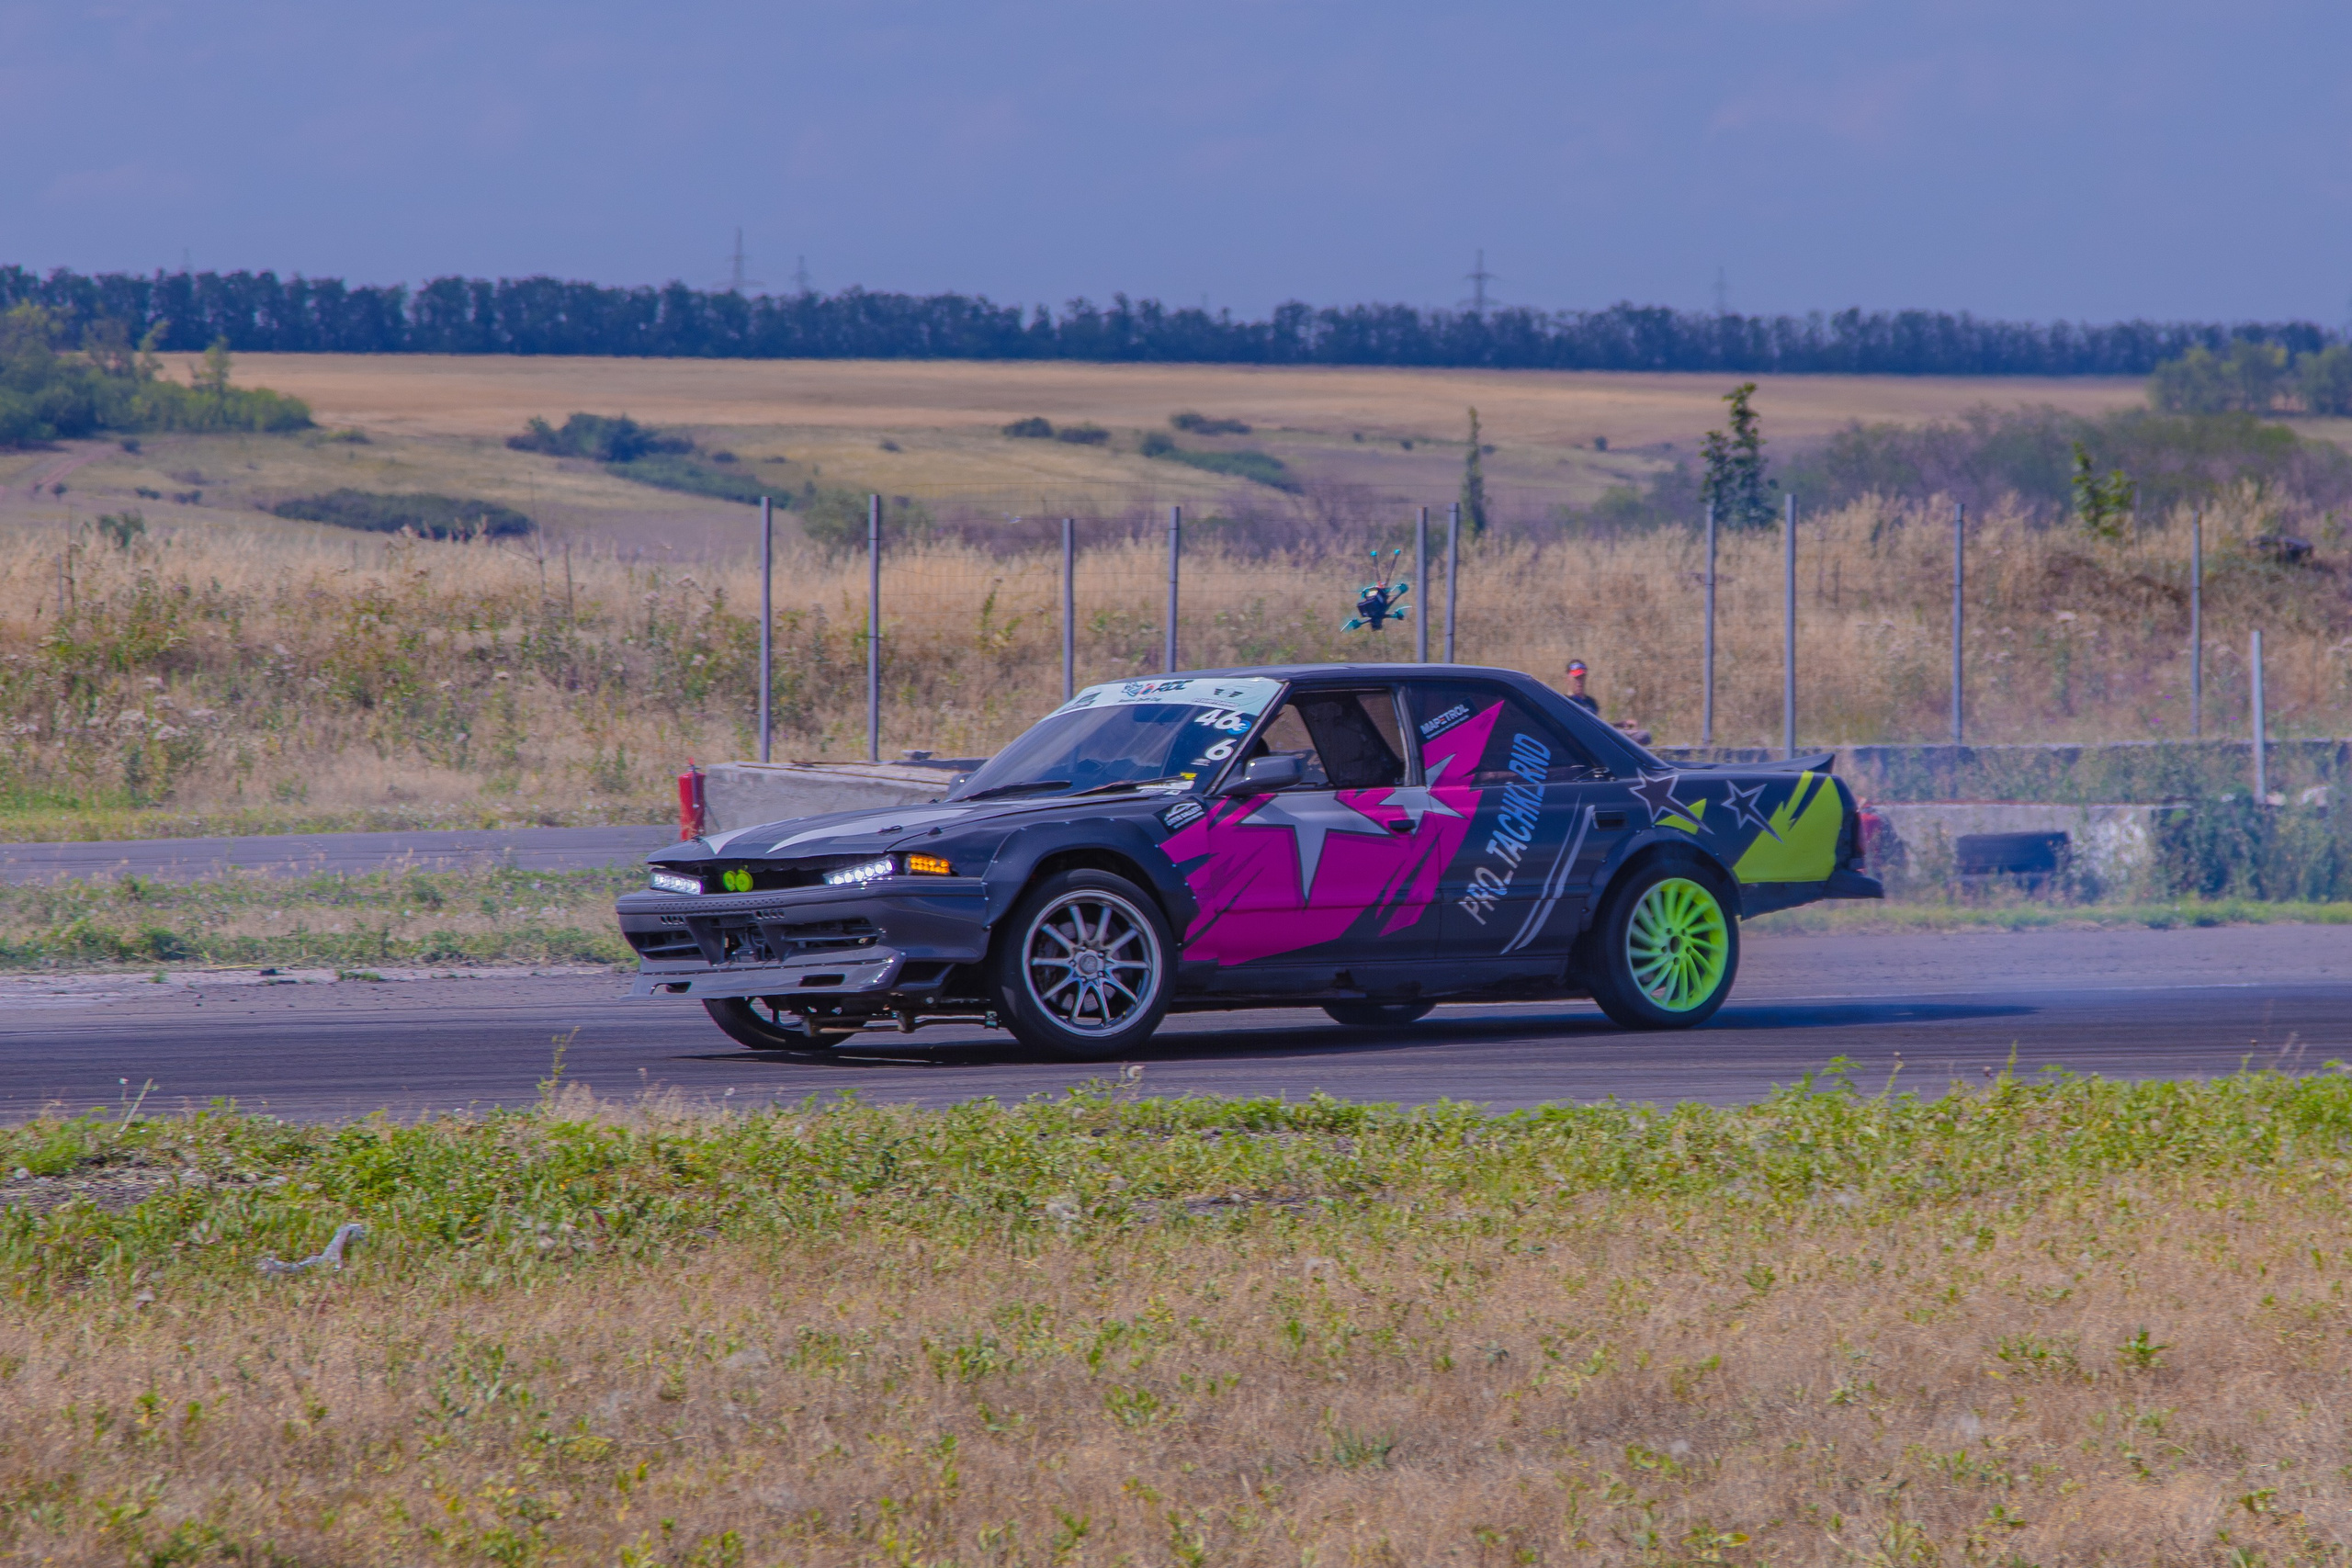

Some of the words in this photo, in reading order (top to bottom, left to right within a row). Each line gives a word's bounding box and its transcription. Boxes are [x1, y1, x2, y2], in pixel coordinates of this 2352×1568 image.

[1193, 708, 1245, 730] 46
[1419, 704, 1470, 735] MAPETROL
[1204, 738, 1238, 761] 6
